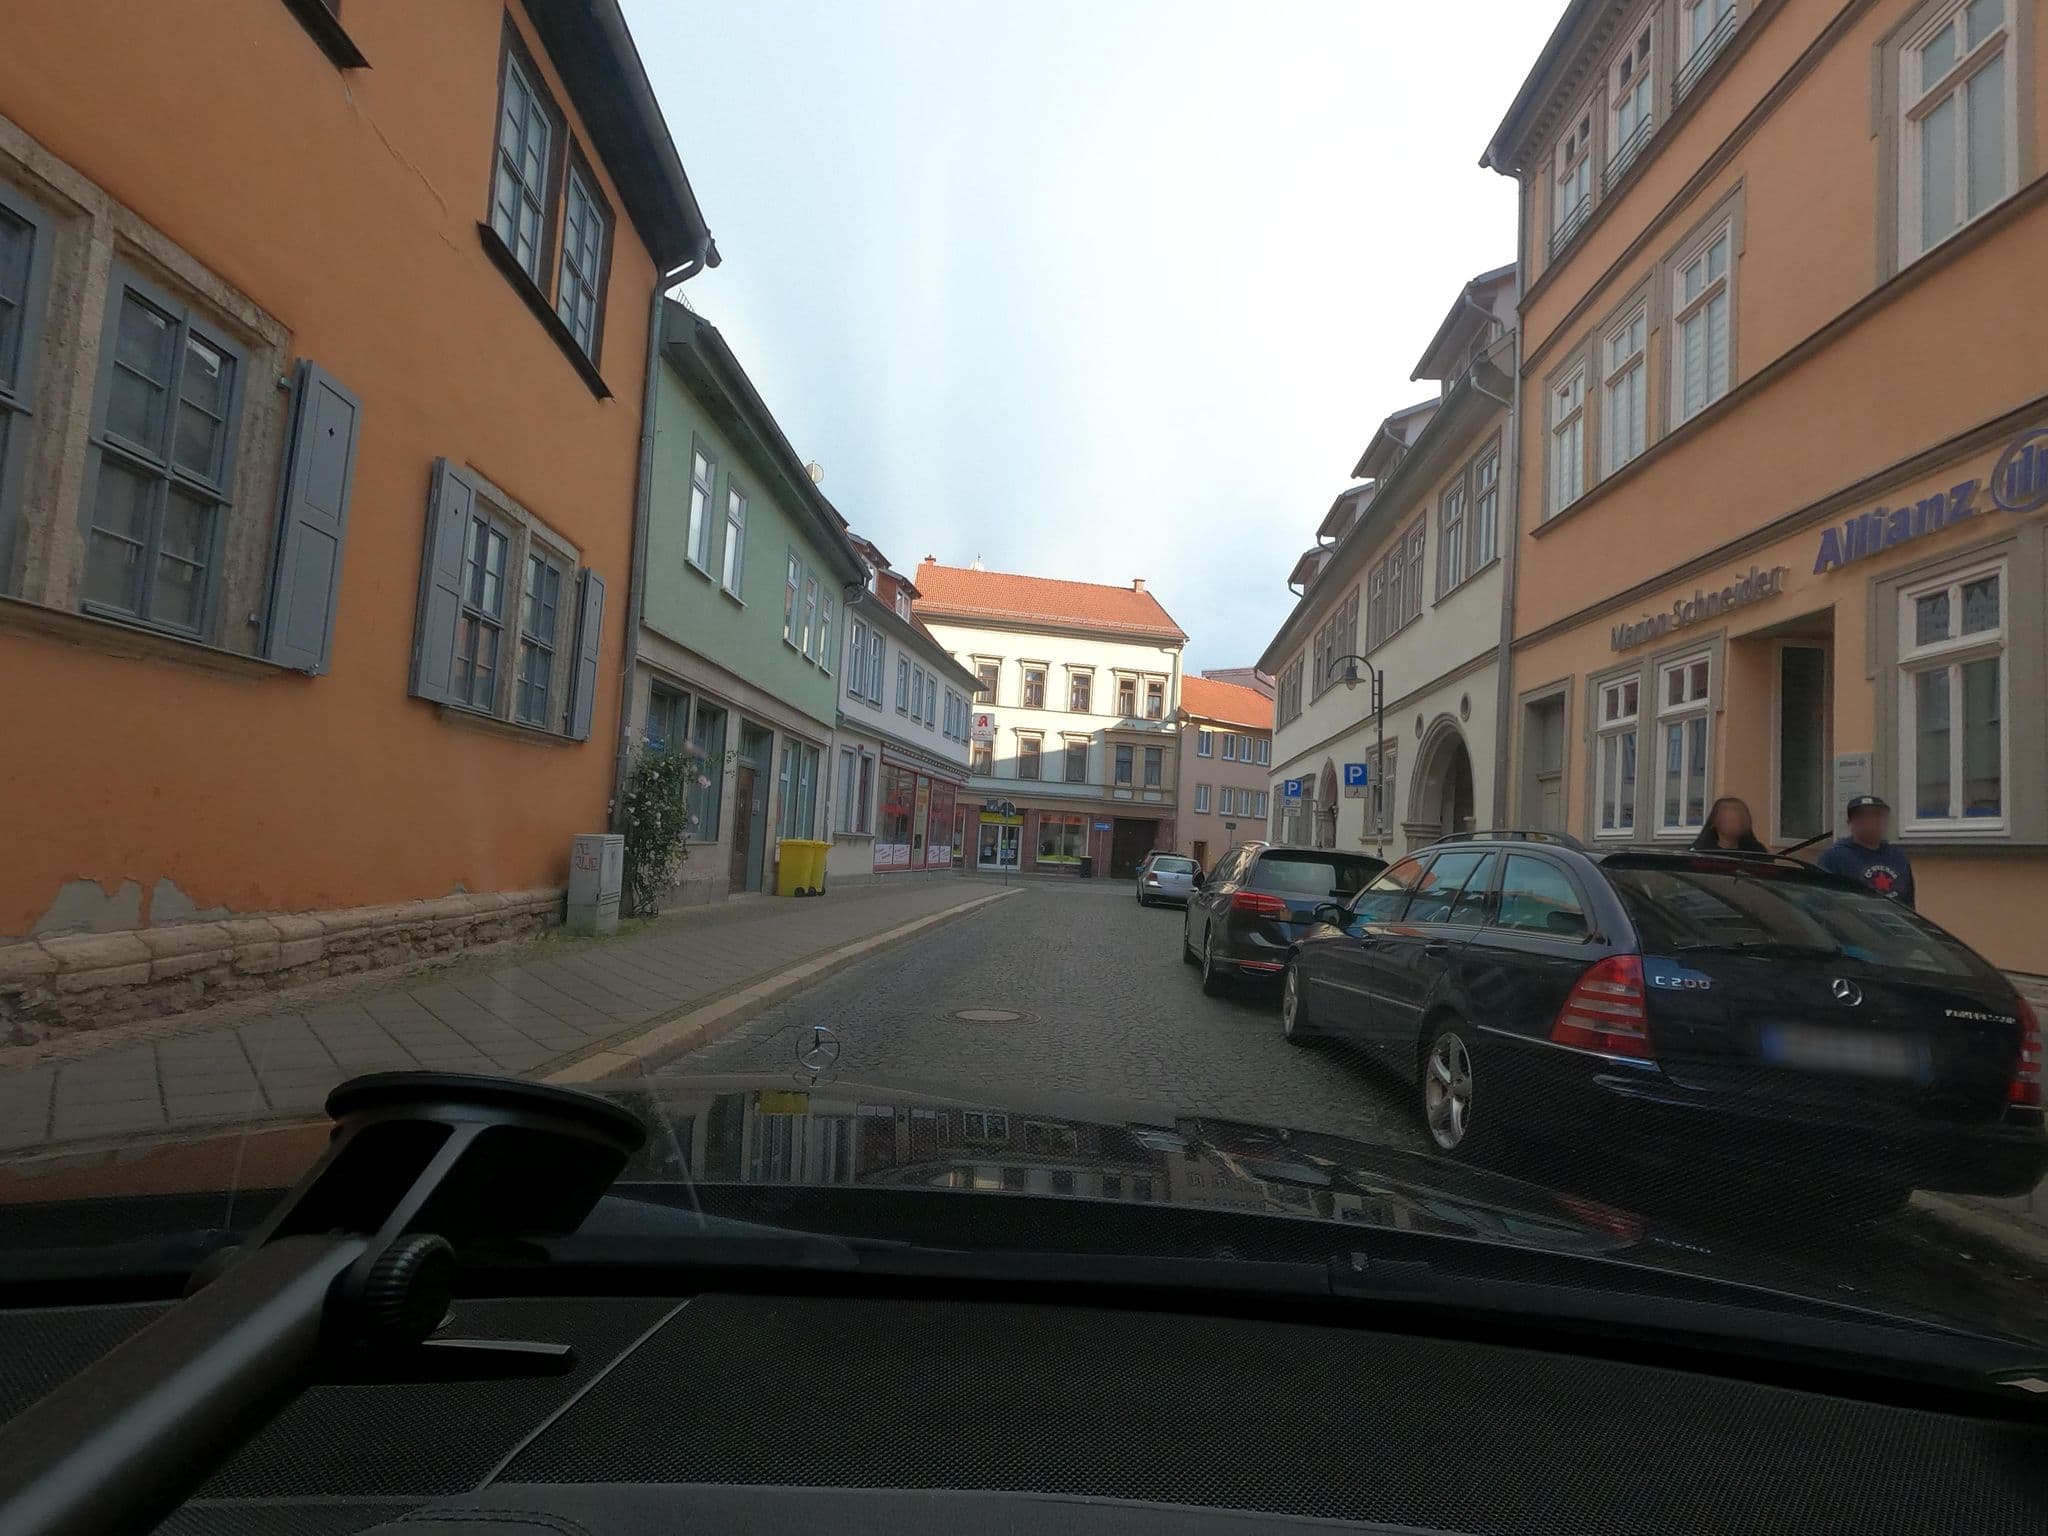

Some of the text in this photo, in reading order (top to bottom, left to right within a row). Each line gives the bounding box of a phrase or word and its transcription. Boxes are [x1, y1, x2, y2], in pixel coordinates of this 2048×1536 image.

[1813, 479, 1977, 575] Allianz
[1673, 565, 1784, 626] Schneider
[1349, 766, 1362, 783] P
[1288, 782, 1298, 795] P
[1655, 975, 1710, 990] C 200
